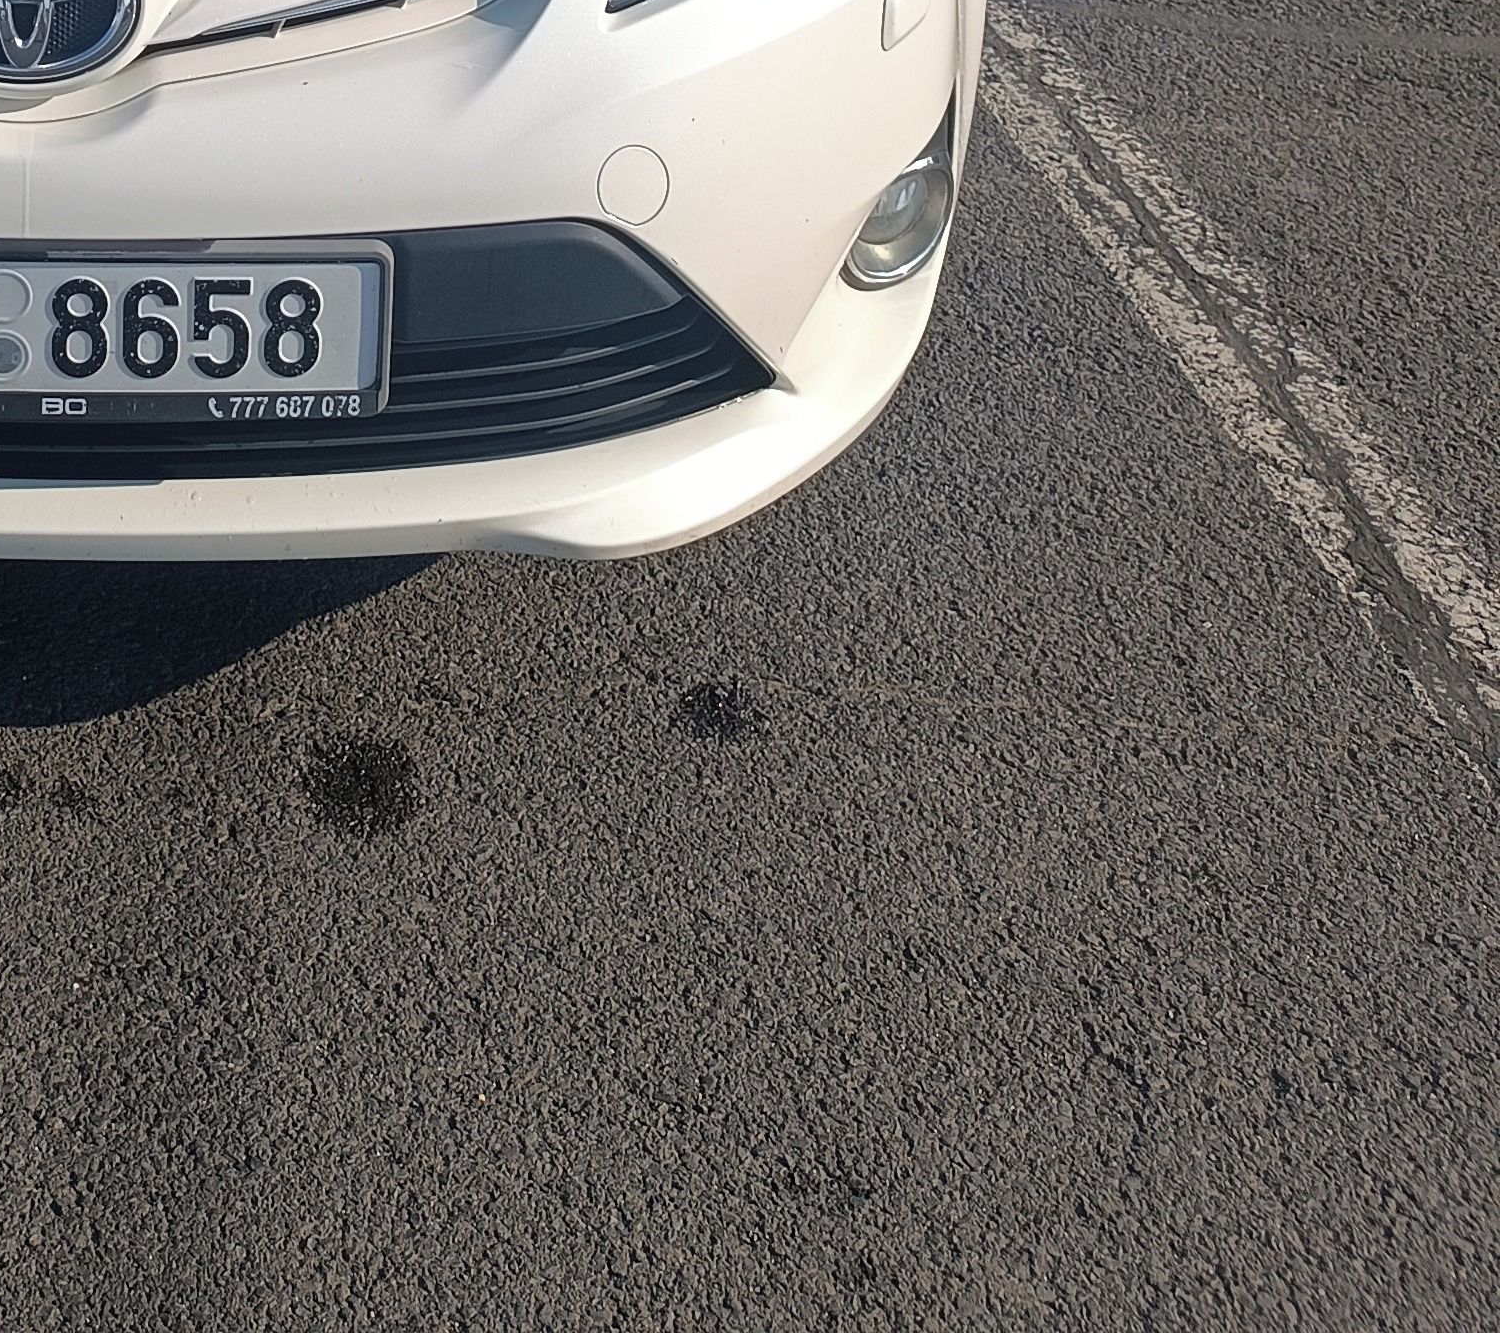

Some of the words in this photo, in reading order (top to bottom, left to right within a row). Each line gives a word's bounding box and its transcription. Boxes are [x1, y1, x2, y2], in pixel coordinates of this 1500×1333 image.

[51, 275, 325, 380] 8658
[229, 396, 269, 418] 777
[321, 395, 361, 417] 078
